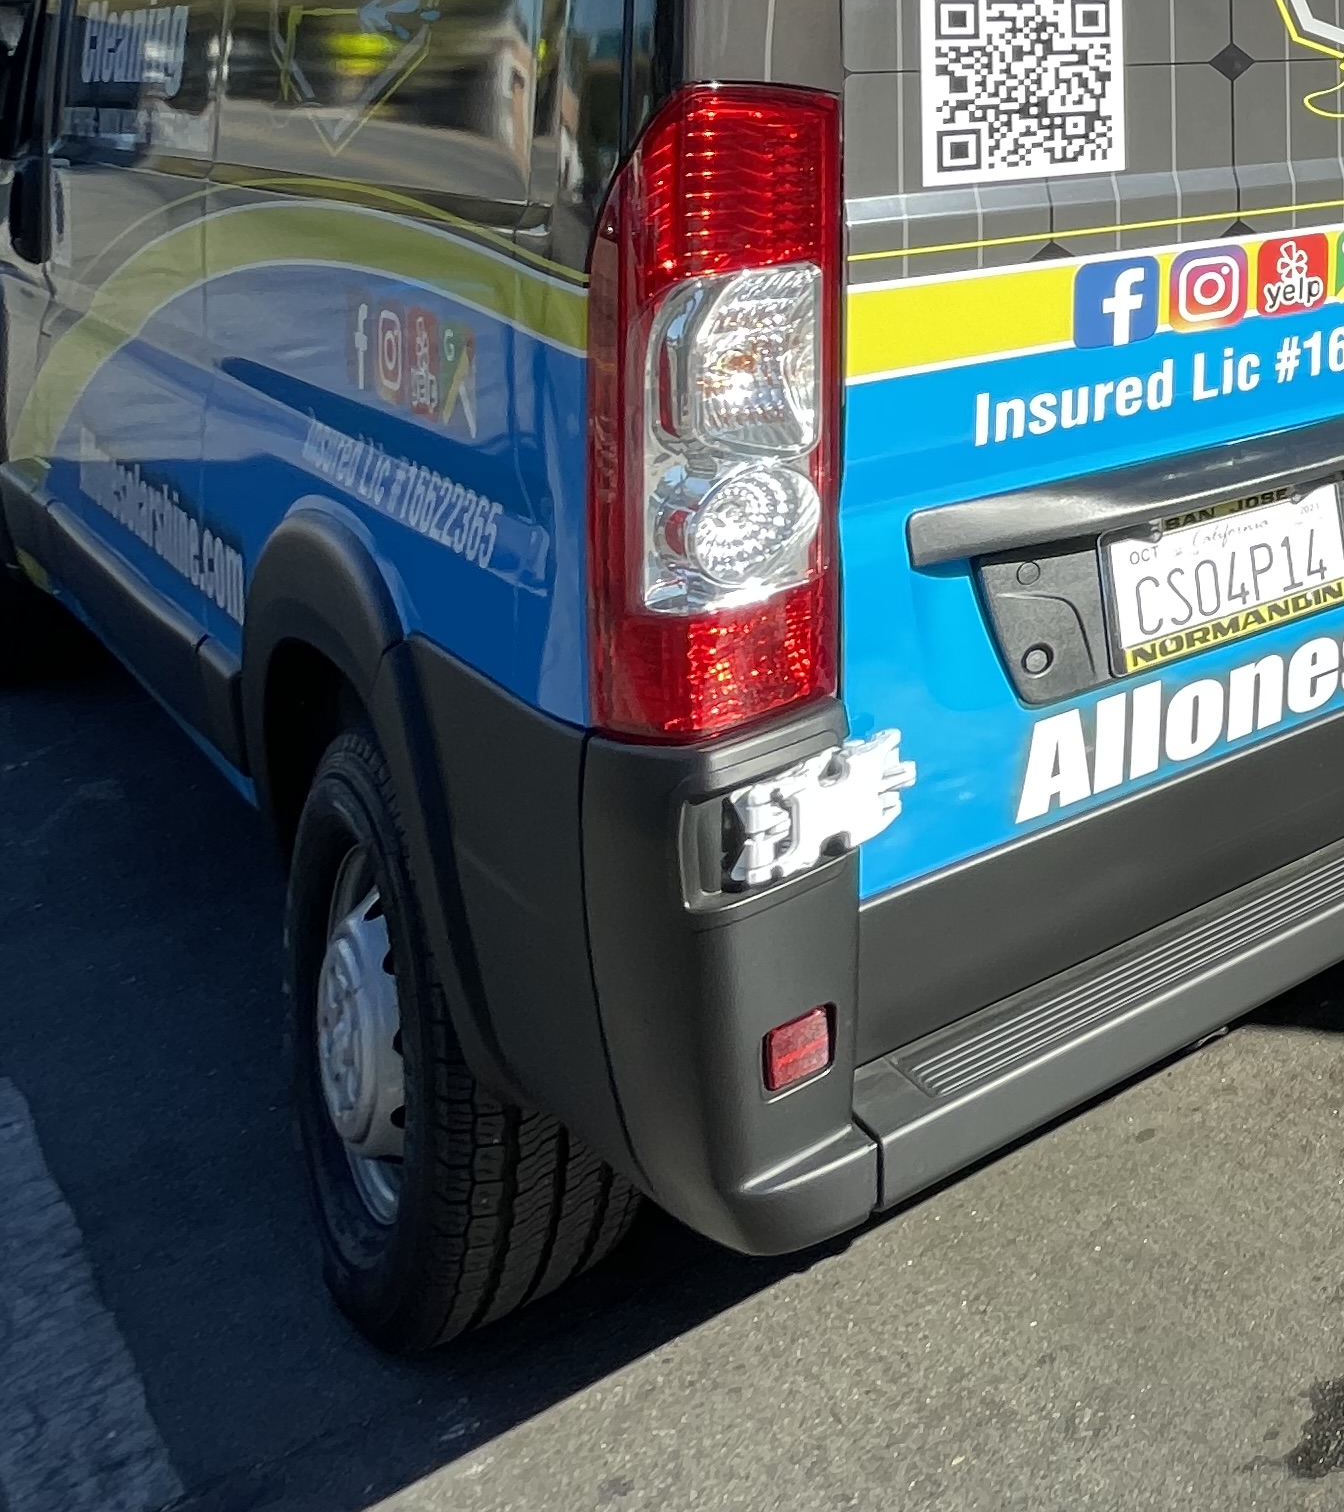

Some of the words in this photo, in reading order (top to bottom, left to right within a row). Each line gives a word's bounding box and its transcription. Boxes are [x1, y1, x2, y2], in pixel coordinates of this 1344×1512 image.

[1265, 275, 1323, 312] yelp
[974, 358, 1173, 446] Insured
[1193, 346, 1260, 402] Lic
[1164, 506, 1216, 532] SAN
[1229, 488, 1289, 514] JOSE
[1129, 545, 1160, 565] OCT
[1132, 582, 1343, 667] NORMANDIN
